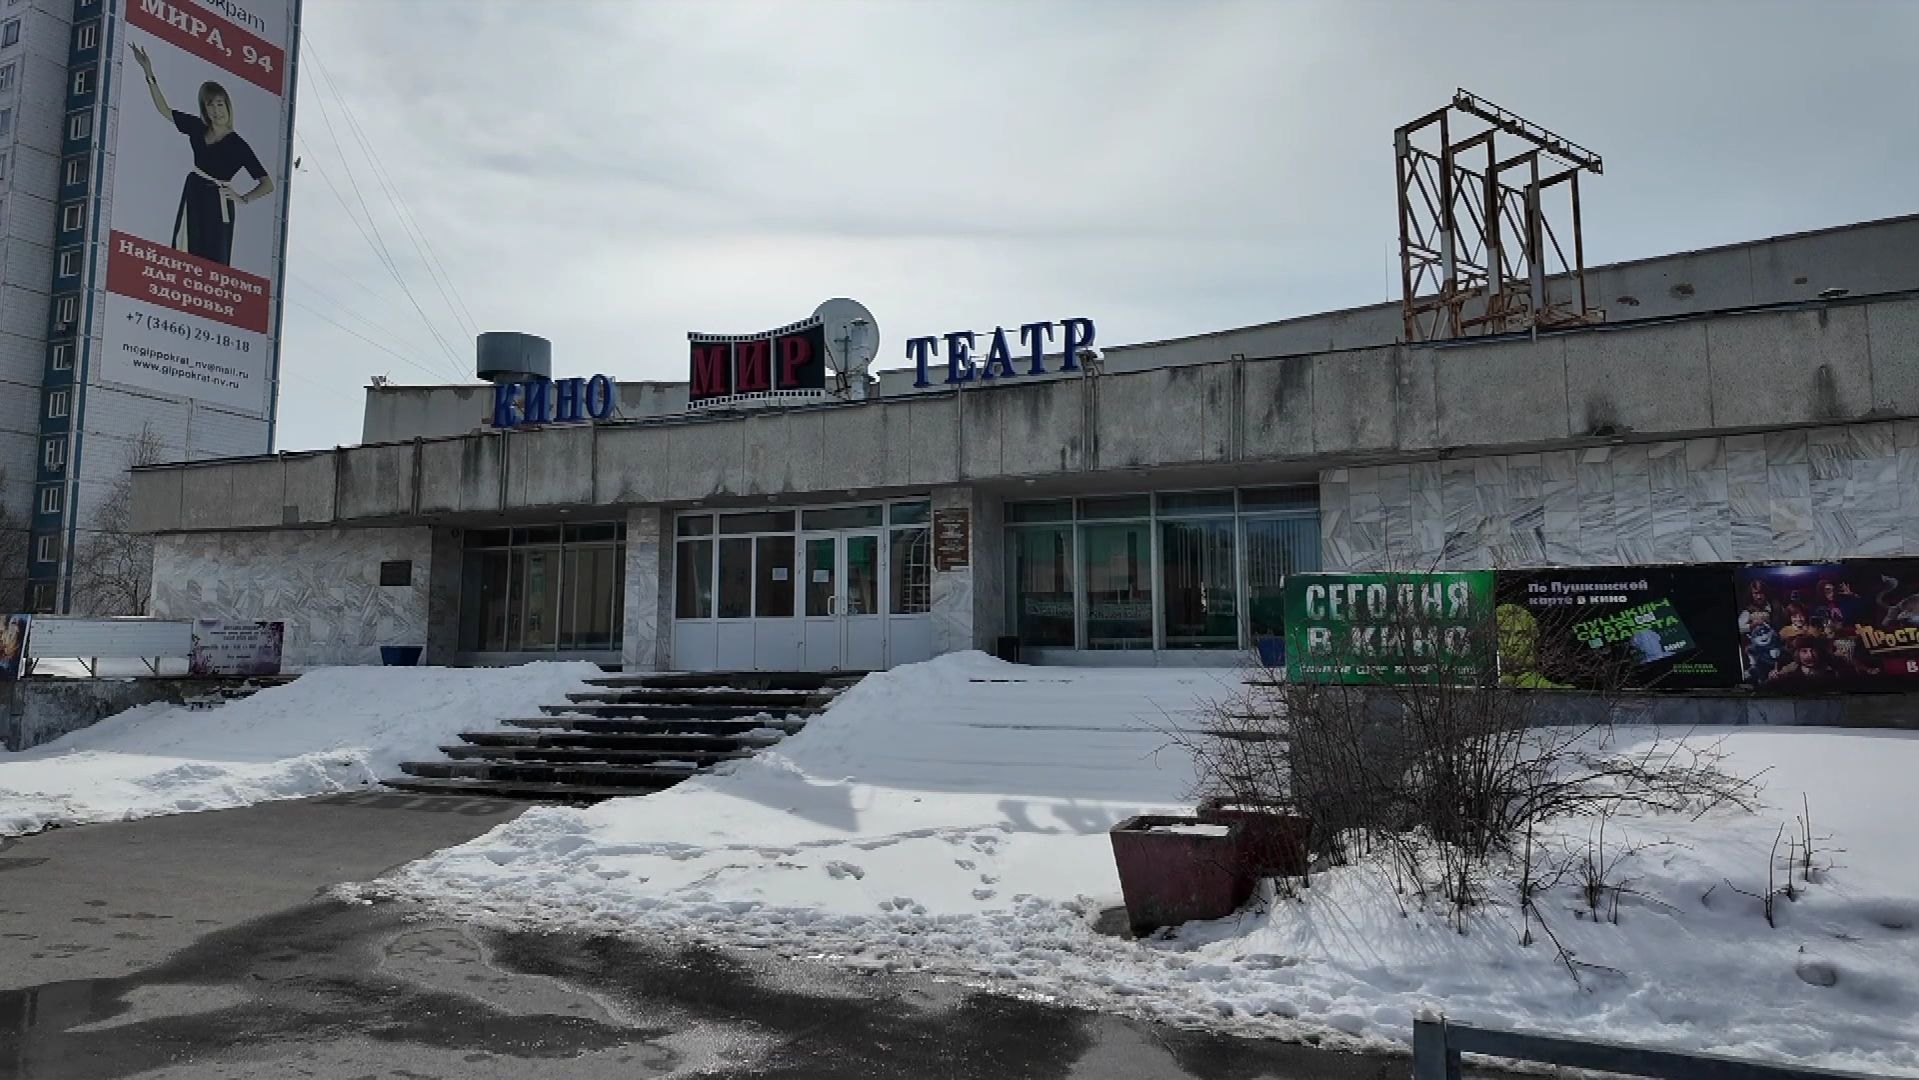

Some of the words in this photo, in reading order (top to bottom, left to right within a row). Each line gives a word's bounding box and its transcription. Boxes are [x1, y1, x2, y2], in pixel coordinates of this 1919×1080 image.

[242, 45, 274, 73] 94
[119, 240, 203, 276] Найдите
[209, 271, 263, 296] время
[142, 265, 176, 285] для
[183, 276, 243, 303] своего
[149, 283, 235, 317] здоровья
[126, 311, 143, 325] +7
[147, 315, 191, 341] (3466)
[194, 328, 250, 353] 29-18-18
[691, 335, 811, 395] МИР
[906, 318, 1096, 388] ТЕАТР
[491, 373, 616, 428] КИНО
[1306, 581, 1470, 620] СЕГОДНЯ
[1528, 583, 1547, 593] По
[1551, 579, 1648, 594] Пушкинской
[1529, 597, 1573, 607] карте
[1589, 595, 1627, 604] кино
[1306, 627, 1332, 656] В
[1351, 625, 1471, 657] КИНО
[1855, 623, 1919, 649] ПРОСТ
